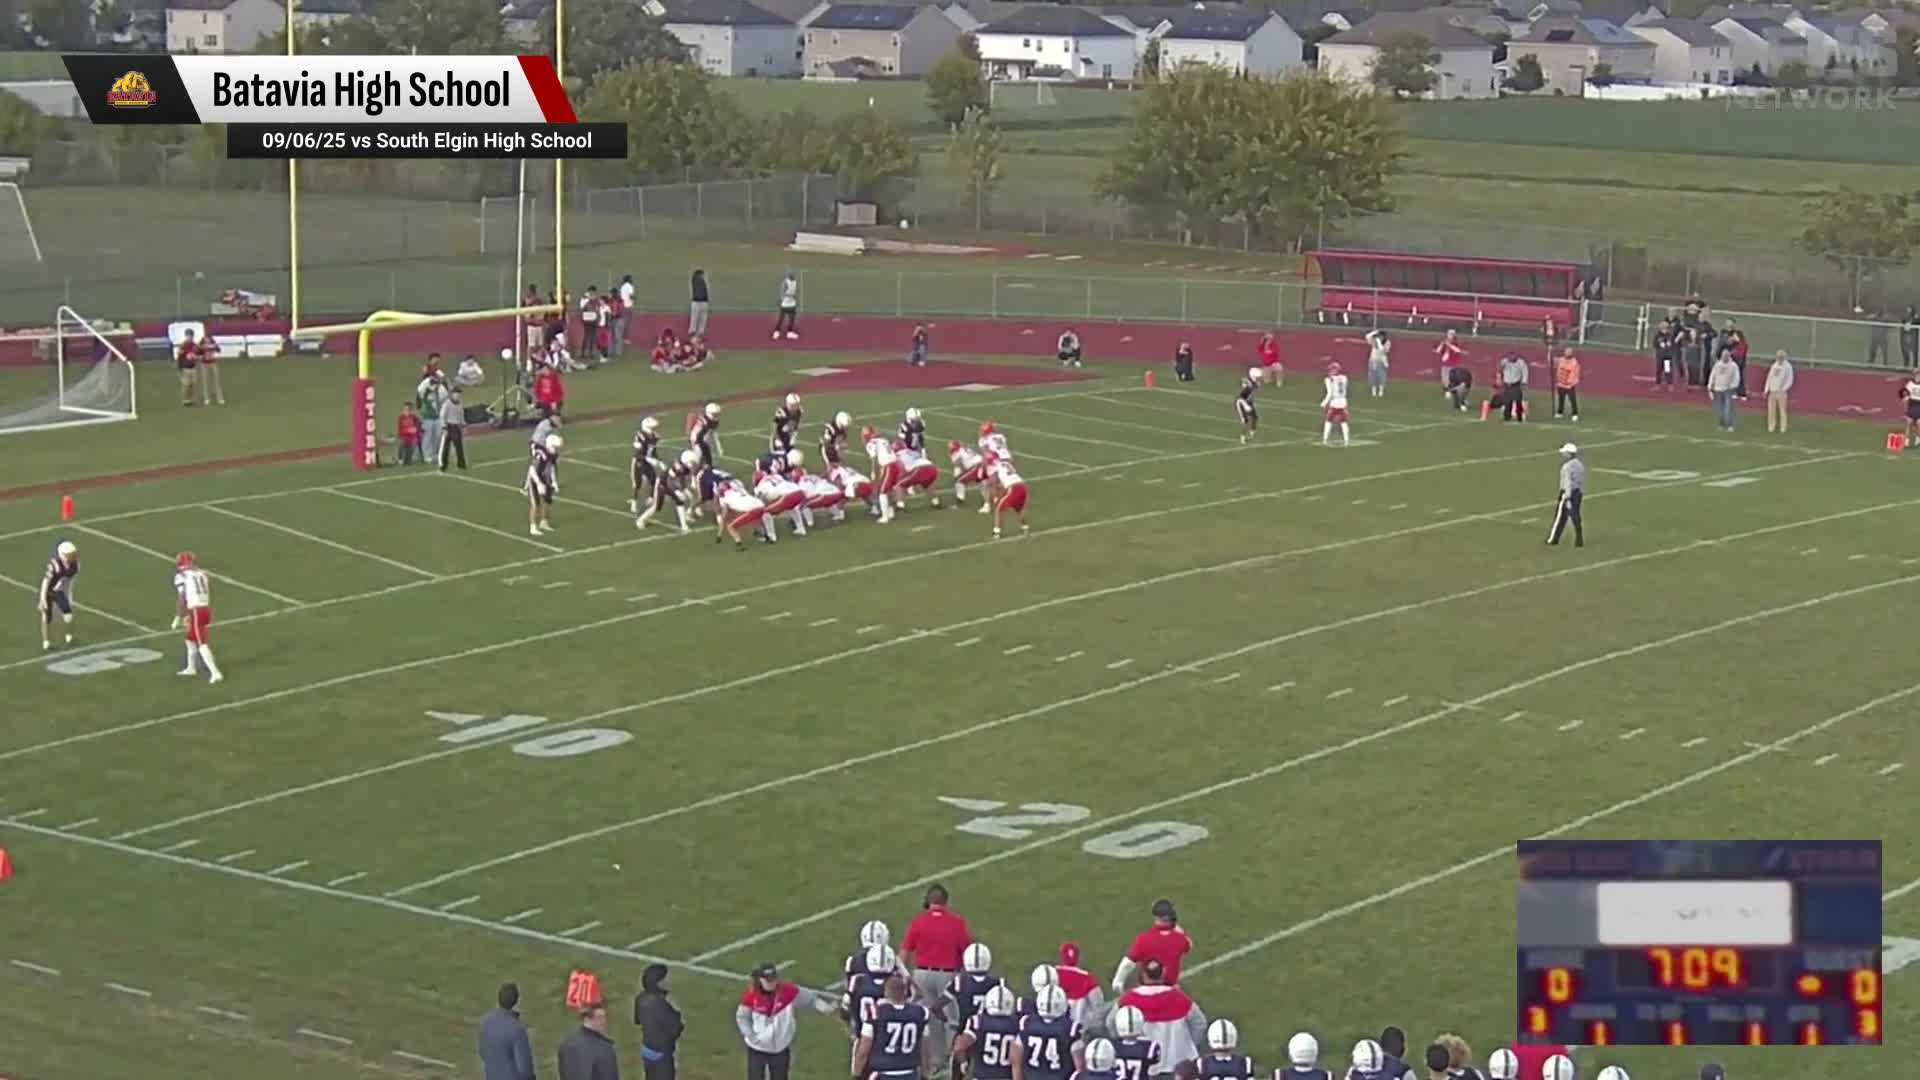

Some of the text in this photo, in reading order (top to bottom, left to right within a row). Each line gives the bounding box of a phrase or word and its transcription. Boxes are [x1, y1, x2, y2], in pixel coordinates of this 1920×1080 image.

[954, 802, 1209, 858] 20
[1549, 968, 1571, 1002] 0
[1853, 969, 1878, 1003] 0
[884, 1021, 918, 1054] 70
[1027, 1035, 1061, 1070] 74
